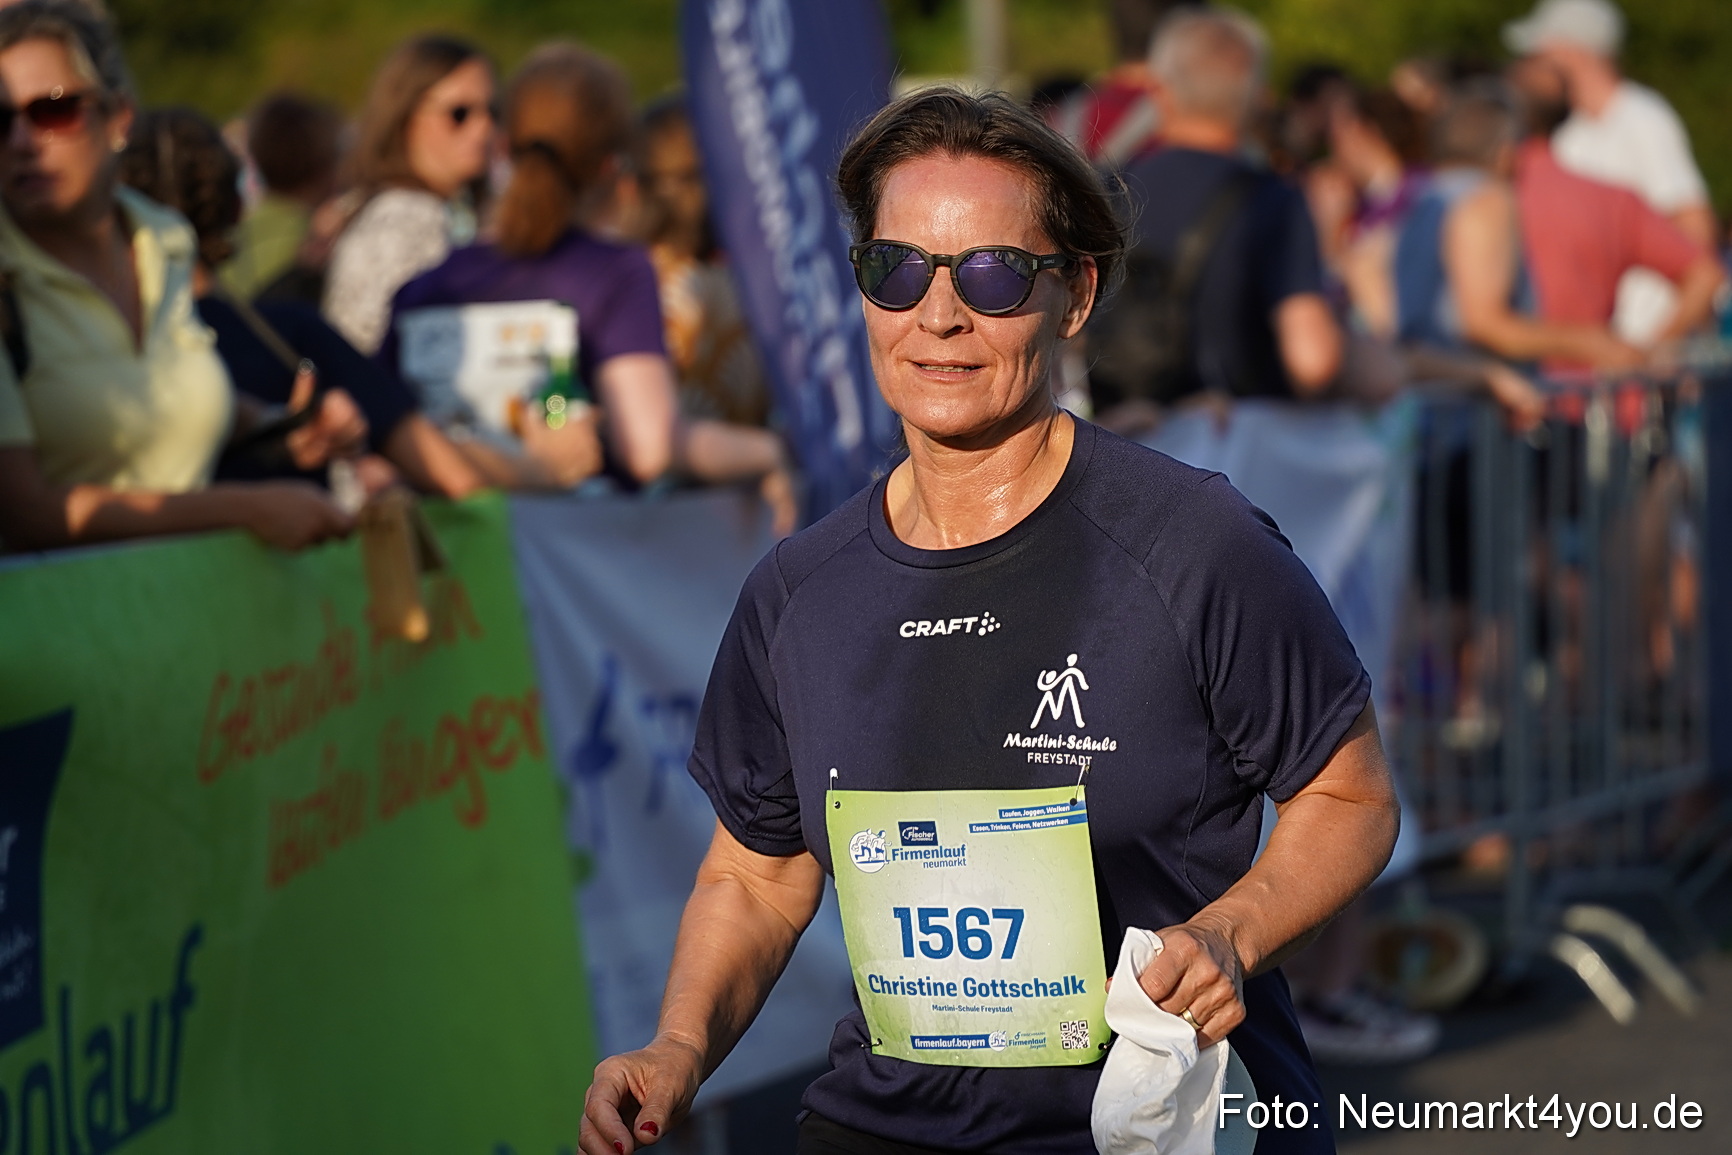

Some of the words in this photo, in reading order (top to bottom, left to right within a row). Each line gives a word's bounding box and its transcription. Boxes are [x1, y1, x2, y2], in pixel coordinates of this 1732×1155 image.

[899, 616, 979, 638] CRAFT
[1003, 732, 1118, 752] Martini-Schule
[1027, 752, 1093, 766] FREYSTADT
[1023, 808, 1045, 817] Joggen,
[1046, 805, 1070, 814] Walken
[1032, 818, 1069, 828] Netzwerken
[891, 843, 966, 861] Firmenlauf
[923, 857, 967, 869] neumarkt
[893, 906, 1025, 960] 1567
[867, 973, 957, 997] Christine
[962, 974, 1087, 998] Gottschalk
[931, 1004, 980, 1013] Martini-Schule
[980, 1005, 1013, 1014] Freystadt
[0, 921, 204, 1155] nlauf
[914, 1038, 986, 1049] firmenlauf.bayern
[1008, 1037, 1047, 1046] Firmenlauf
